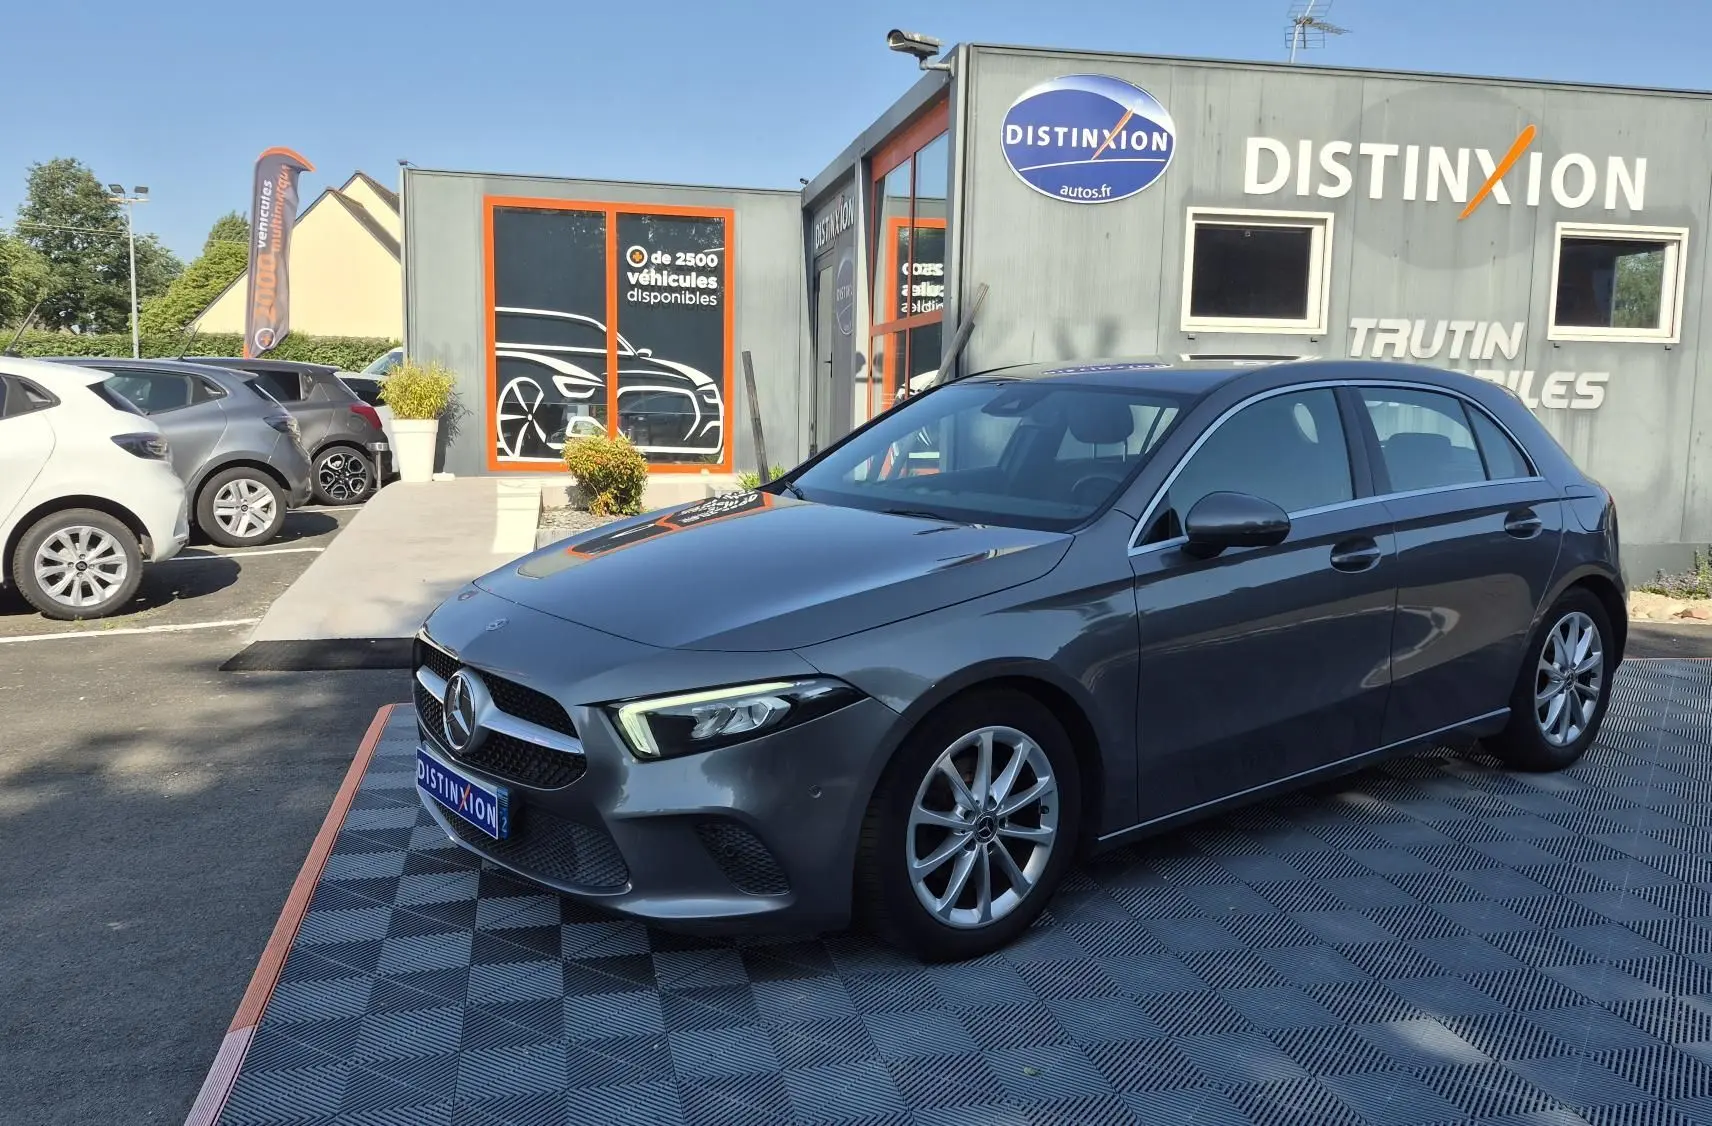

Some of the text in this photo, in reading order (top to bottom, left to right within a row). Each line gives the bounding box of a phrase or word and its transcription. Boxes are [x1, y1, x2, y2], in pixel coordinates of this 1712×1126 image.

[1006, 108, 1168, 161] DISTINXION
[1244, 124, 1648, 220] DISTINXION
[1060, 183, 1112, 199] autos.fr
[651, 251, 718, 267] de 2500
[627, 268, 718, 289] véhicules
[627, 288, 718, 306] disponibles
[1350, 318, 1525, 360] TRUTIN
[418, 758, 496, 829] DISTINXION
